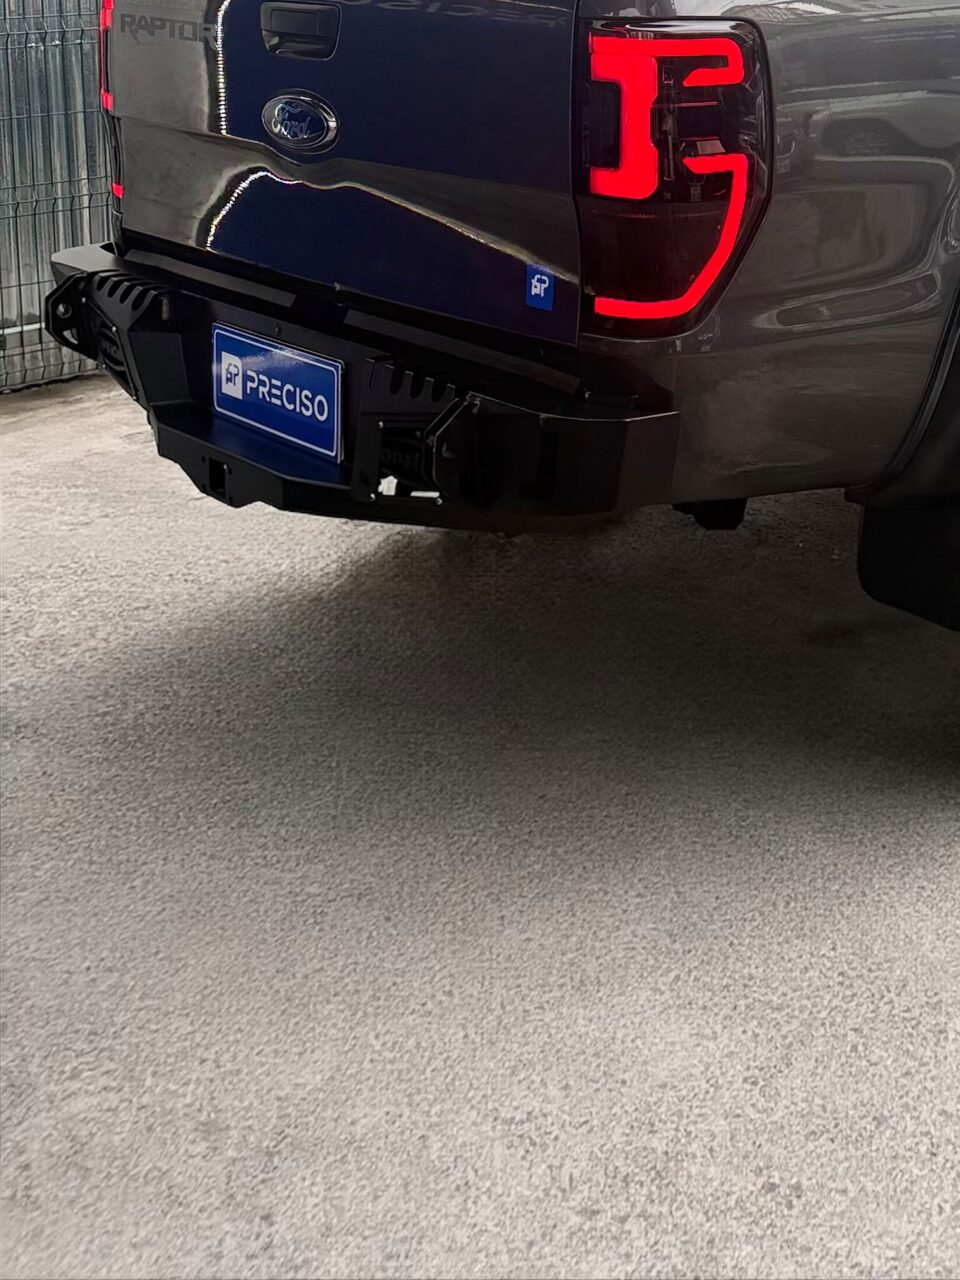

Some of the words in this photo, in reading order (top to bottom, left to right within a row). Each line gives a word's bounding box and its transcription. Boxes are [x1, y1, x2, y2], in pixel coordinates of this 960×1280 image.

[120, 13, 218, 51] RAPTOR
[270, 104, 318, 140] Ford
[247, 371, 328, 421] PRECISO
